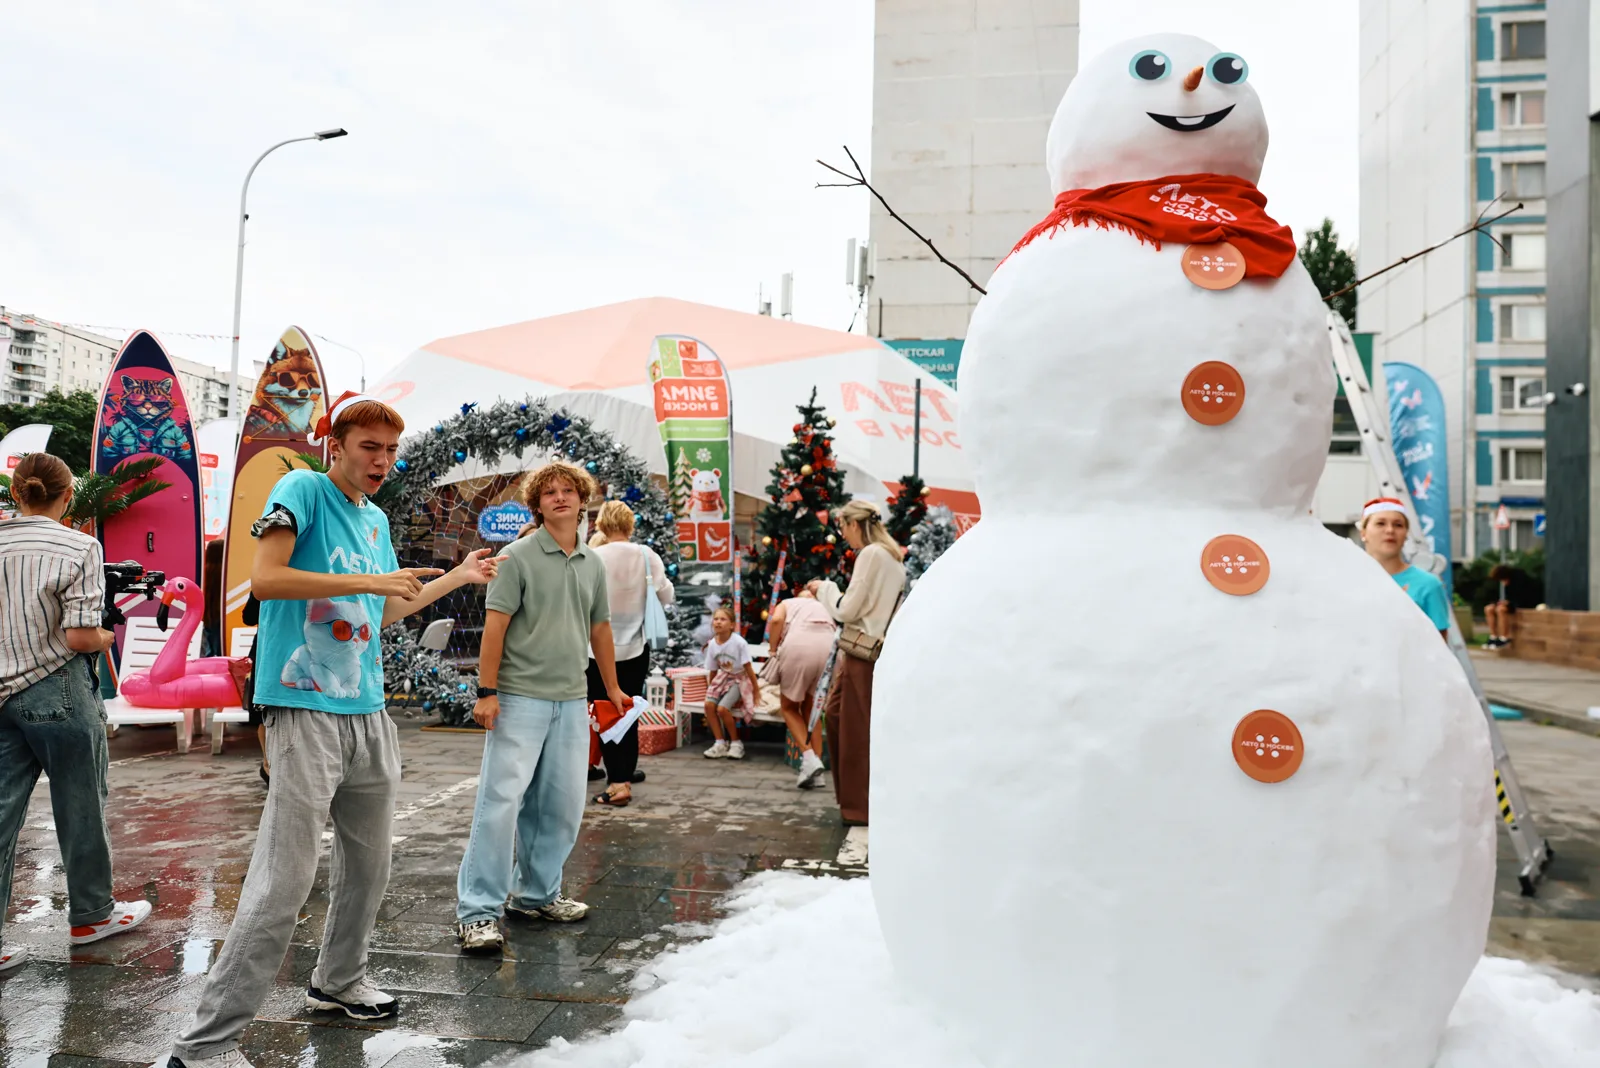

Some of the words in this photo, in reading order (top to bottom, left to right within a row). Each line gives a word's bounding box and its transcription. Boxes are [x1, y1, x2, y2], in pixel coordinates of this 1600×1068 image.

[1157, 183, 1238, 222] ЛЕТО
[840, 380, 954, 422] ЛЕТ
[495, 512, 526, 523] ЗИМА
[490, 522, 497, 531] В
[498, 522, 522, 531] МОСК
[1241, 740, 1259, 748] ЛЕТО
[1266, 743, 1294, 751] МОСКВЕ
